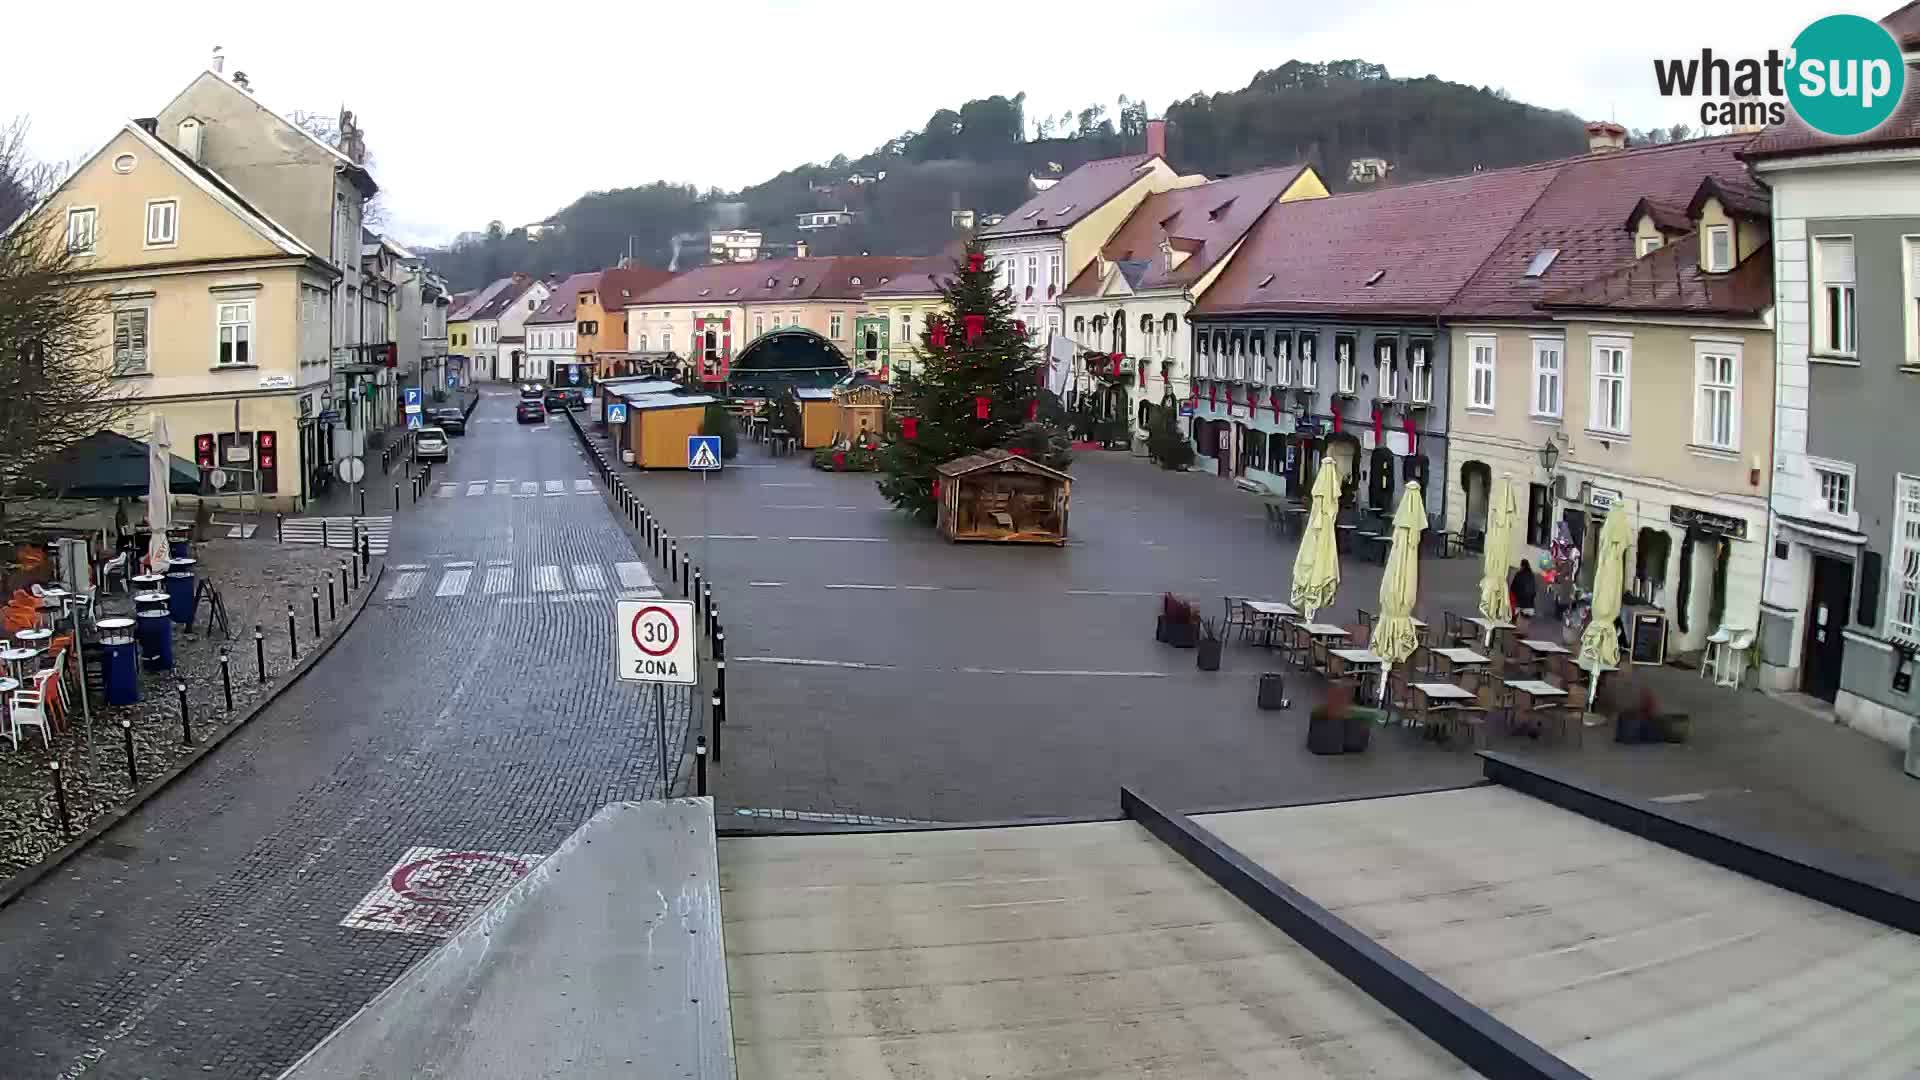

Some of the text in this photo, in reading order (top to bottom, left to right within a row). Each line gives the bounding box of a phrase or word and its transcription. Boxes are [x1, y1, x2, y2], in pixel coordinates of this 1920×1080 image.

[409, 391, 417, 402] P
[643, 622, 668, 643] 30
[634, 659, 679, 677] ZONA
